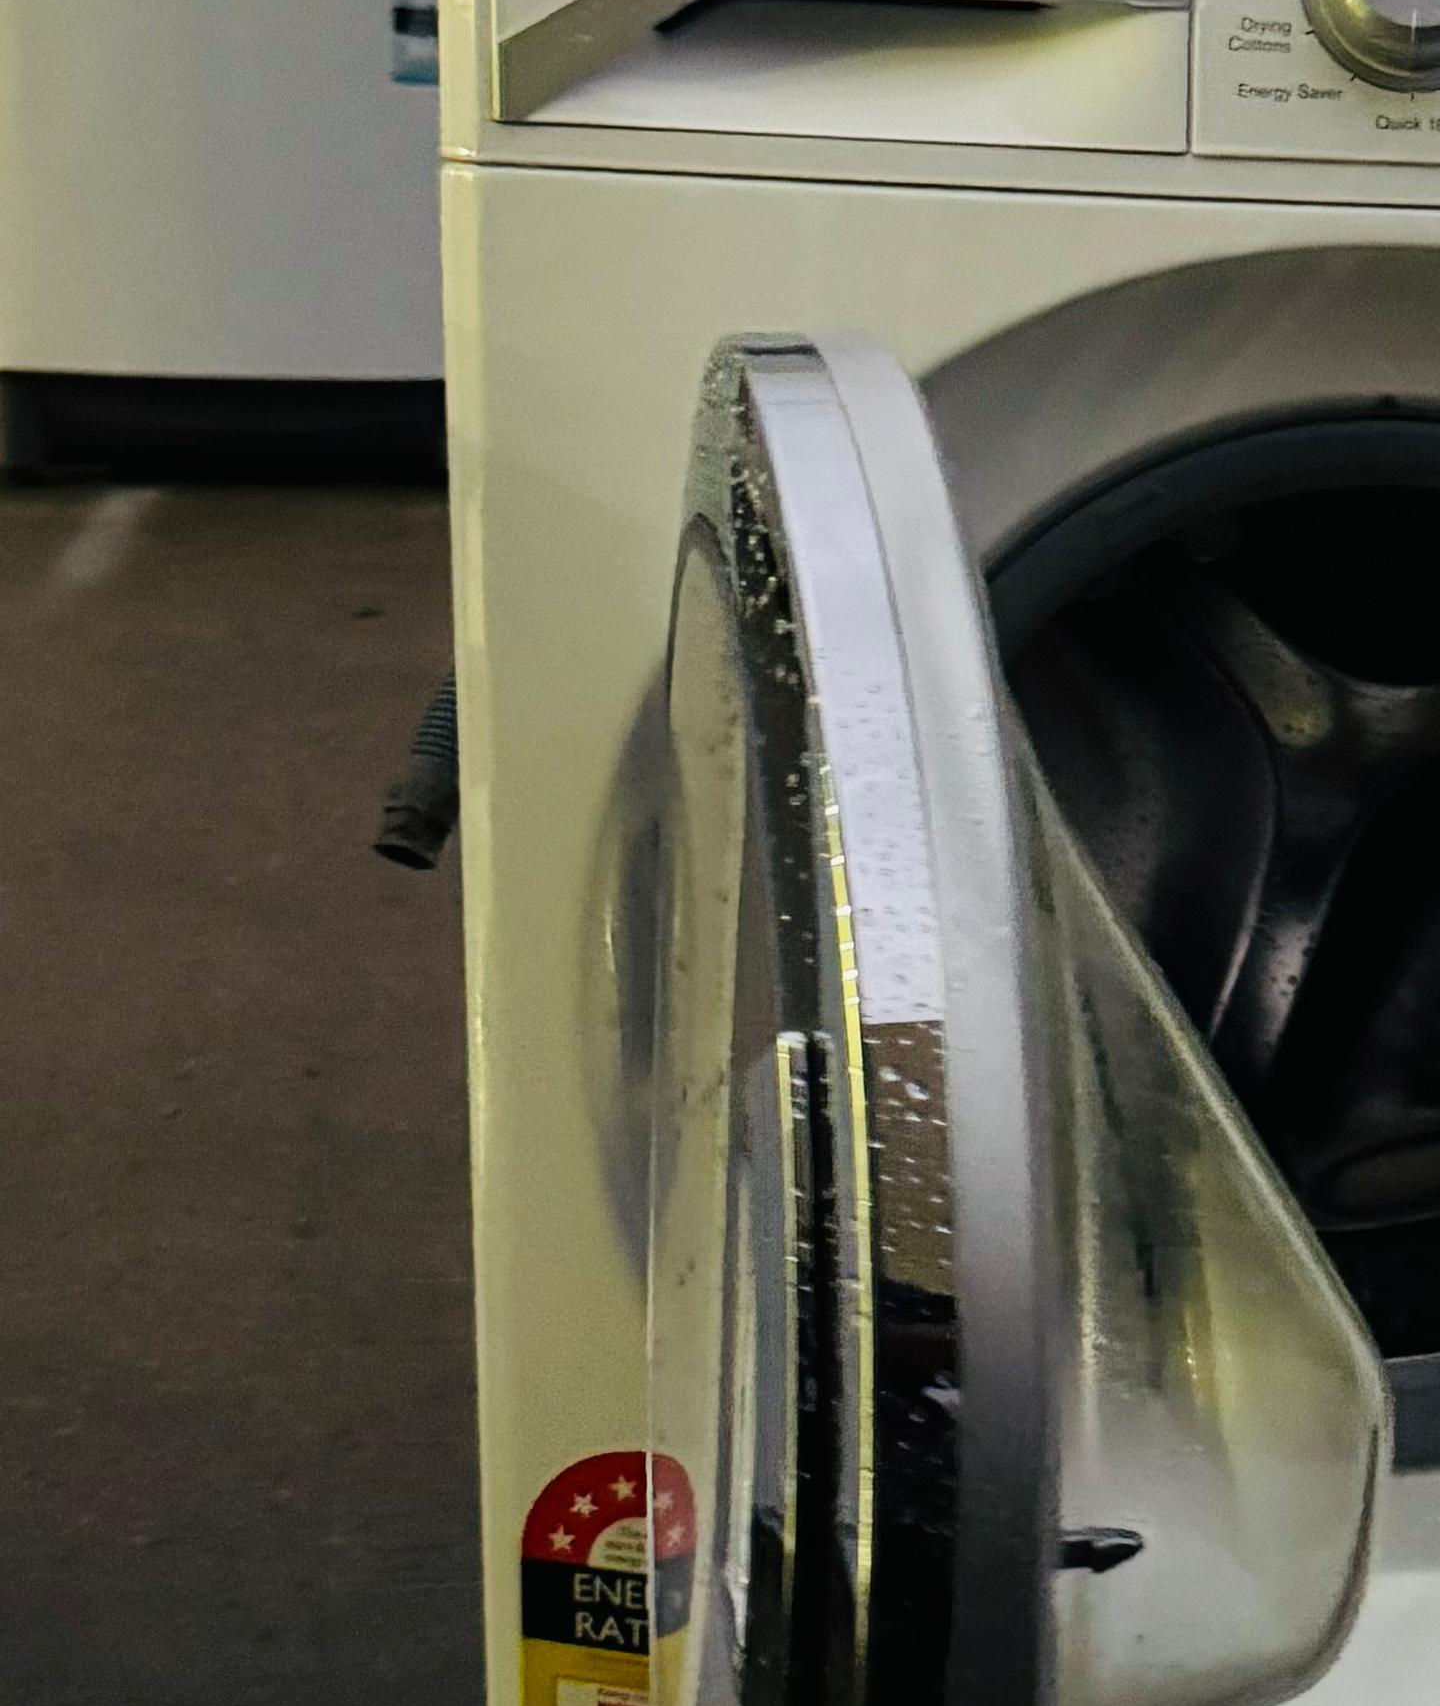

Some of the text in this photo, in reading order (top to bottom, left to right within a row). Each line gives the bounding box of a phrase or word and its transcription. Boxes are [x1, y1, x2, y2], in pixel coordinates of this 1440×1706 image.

[1241, 17, 1292, 37] Drying
[1229, 35, 1292, 54] Cottons
[1238, 83, 1343, 103] Energy Saver
[1375, 114, 1421, 130] Quick
[572, 1573, 648, 1612] ENE
[575, 1611, 649, 1649] RAT
